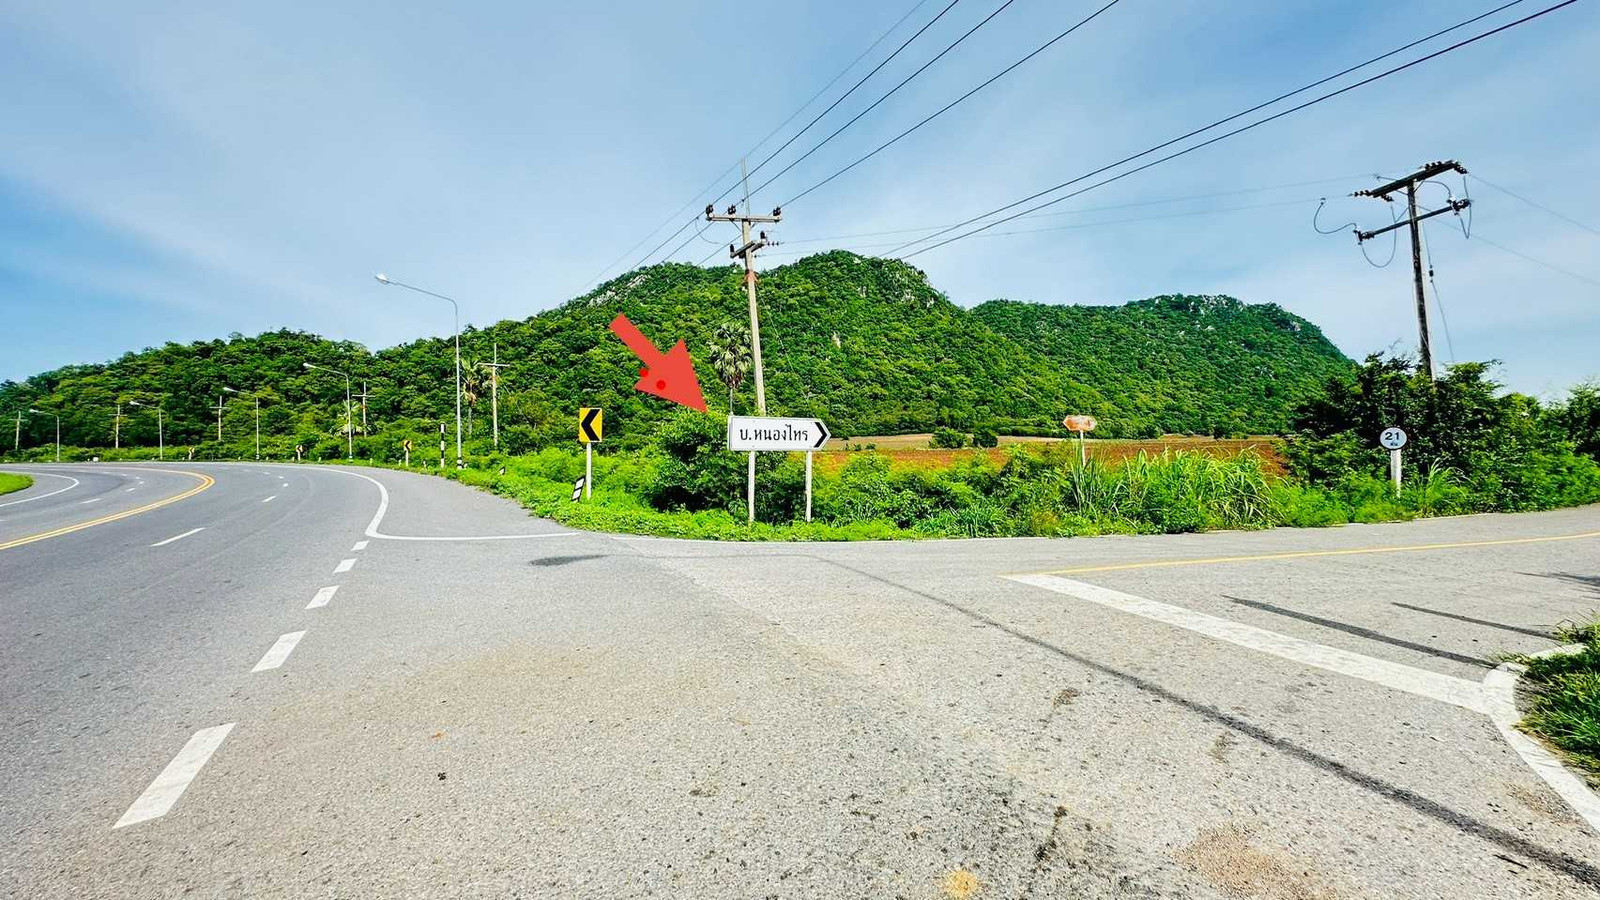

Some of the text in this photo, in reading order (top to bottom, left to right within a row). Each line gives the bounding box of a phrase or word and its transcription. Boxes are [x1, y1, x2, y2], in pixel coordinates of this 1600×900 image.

[740, 424, 808, 441] บ.หนองไทร
[1385, 432, 1400, 440] 21
